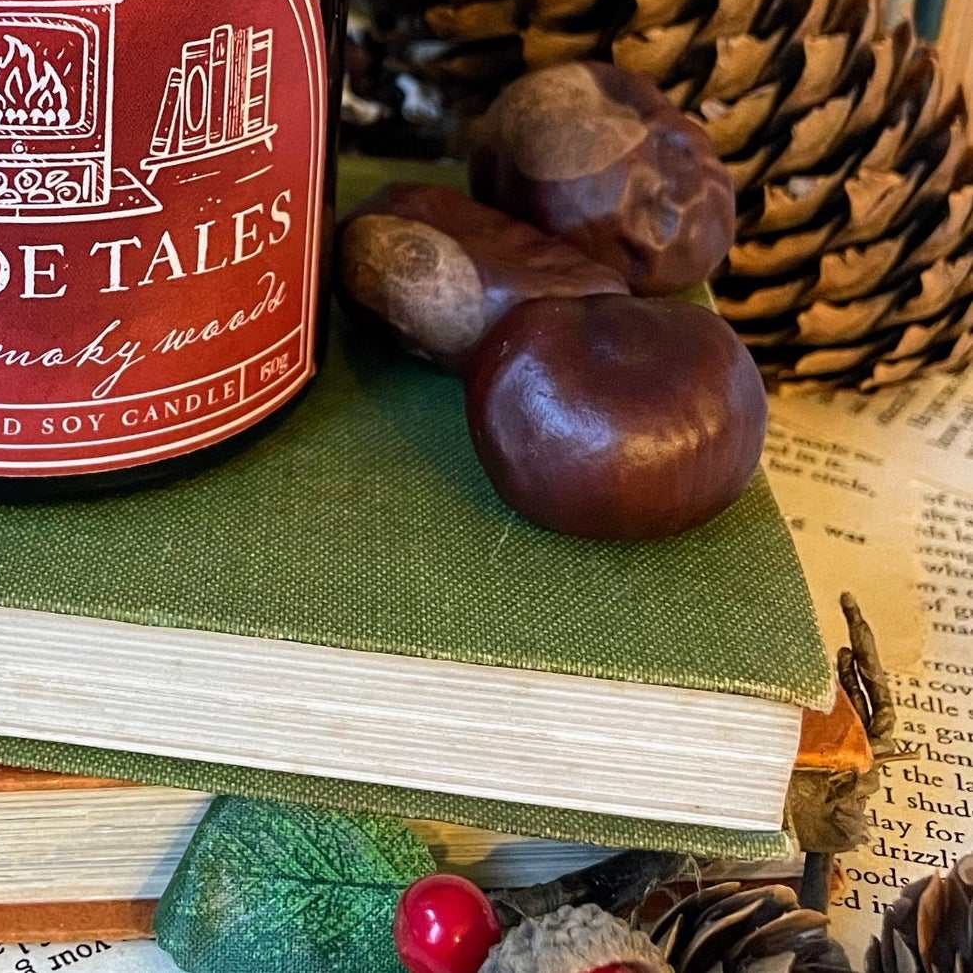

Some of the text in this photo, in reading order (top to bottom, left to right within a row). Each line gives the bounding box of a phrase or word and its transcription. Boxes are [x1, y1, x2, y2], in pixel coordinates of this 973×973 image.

[89, 189, 292, 293] TALES
[152, 271, 287, 354] woods
[41, 413, 106, 435] SOY
[121, 379, 236, 427] CANDLE
[909, 677, 922, 688] a
[903, 721, 927, 735] as
[903, 765, 945, 788] the
[884, 787, 896, 805] I
[925, 820, 965, 844] for
[839, 864, 911, 889] oods
